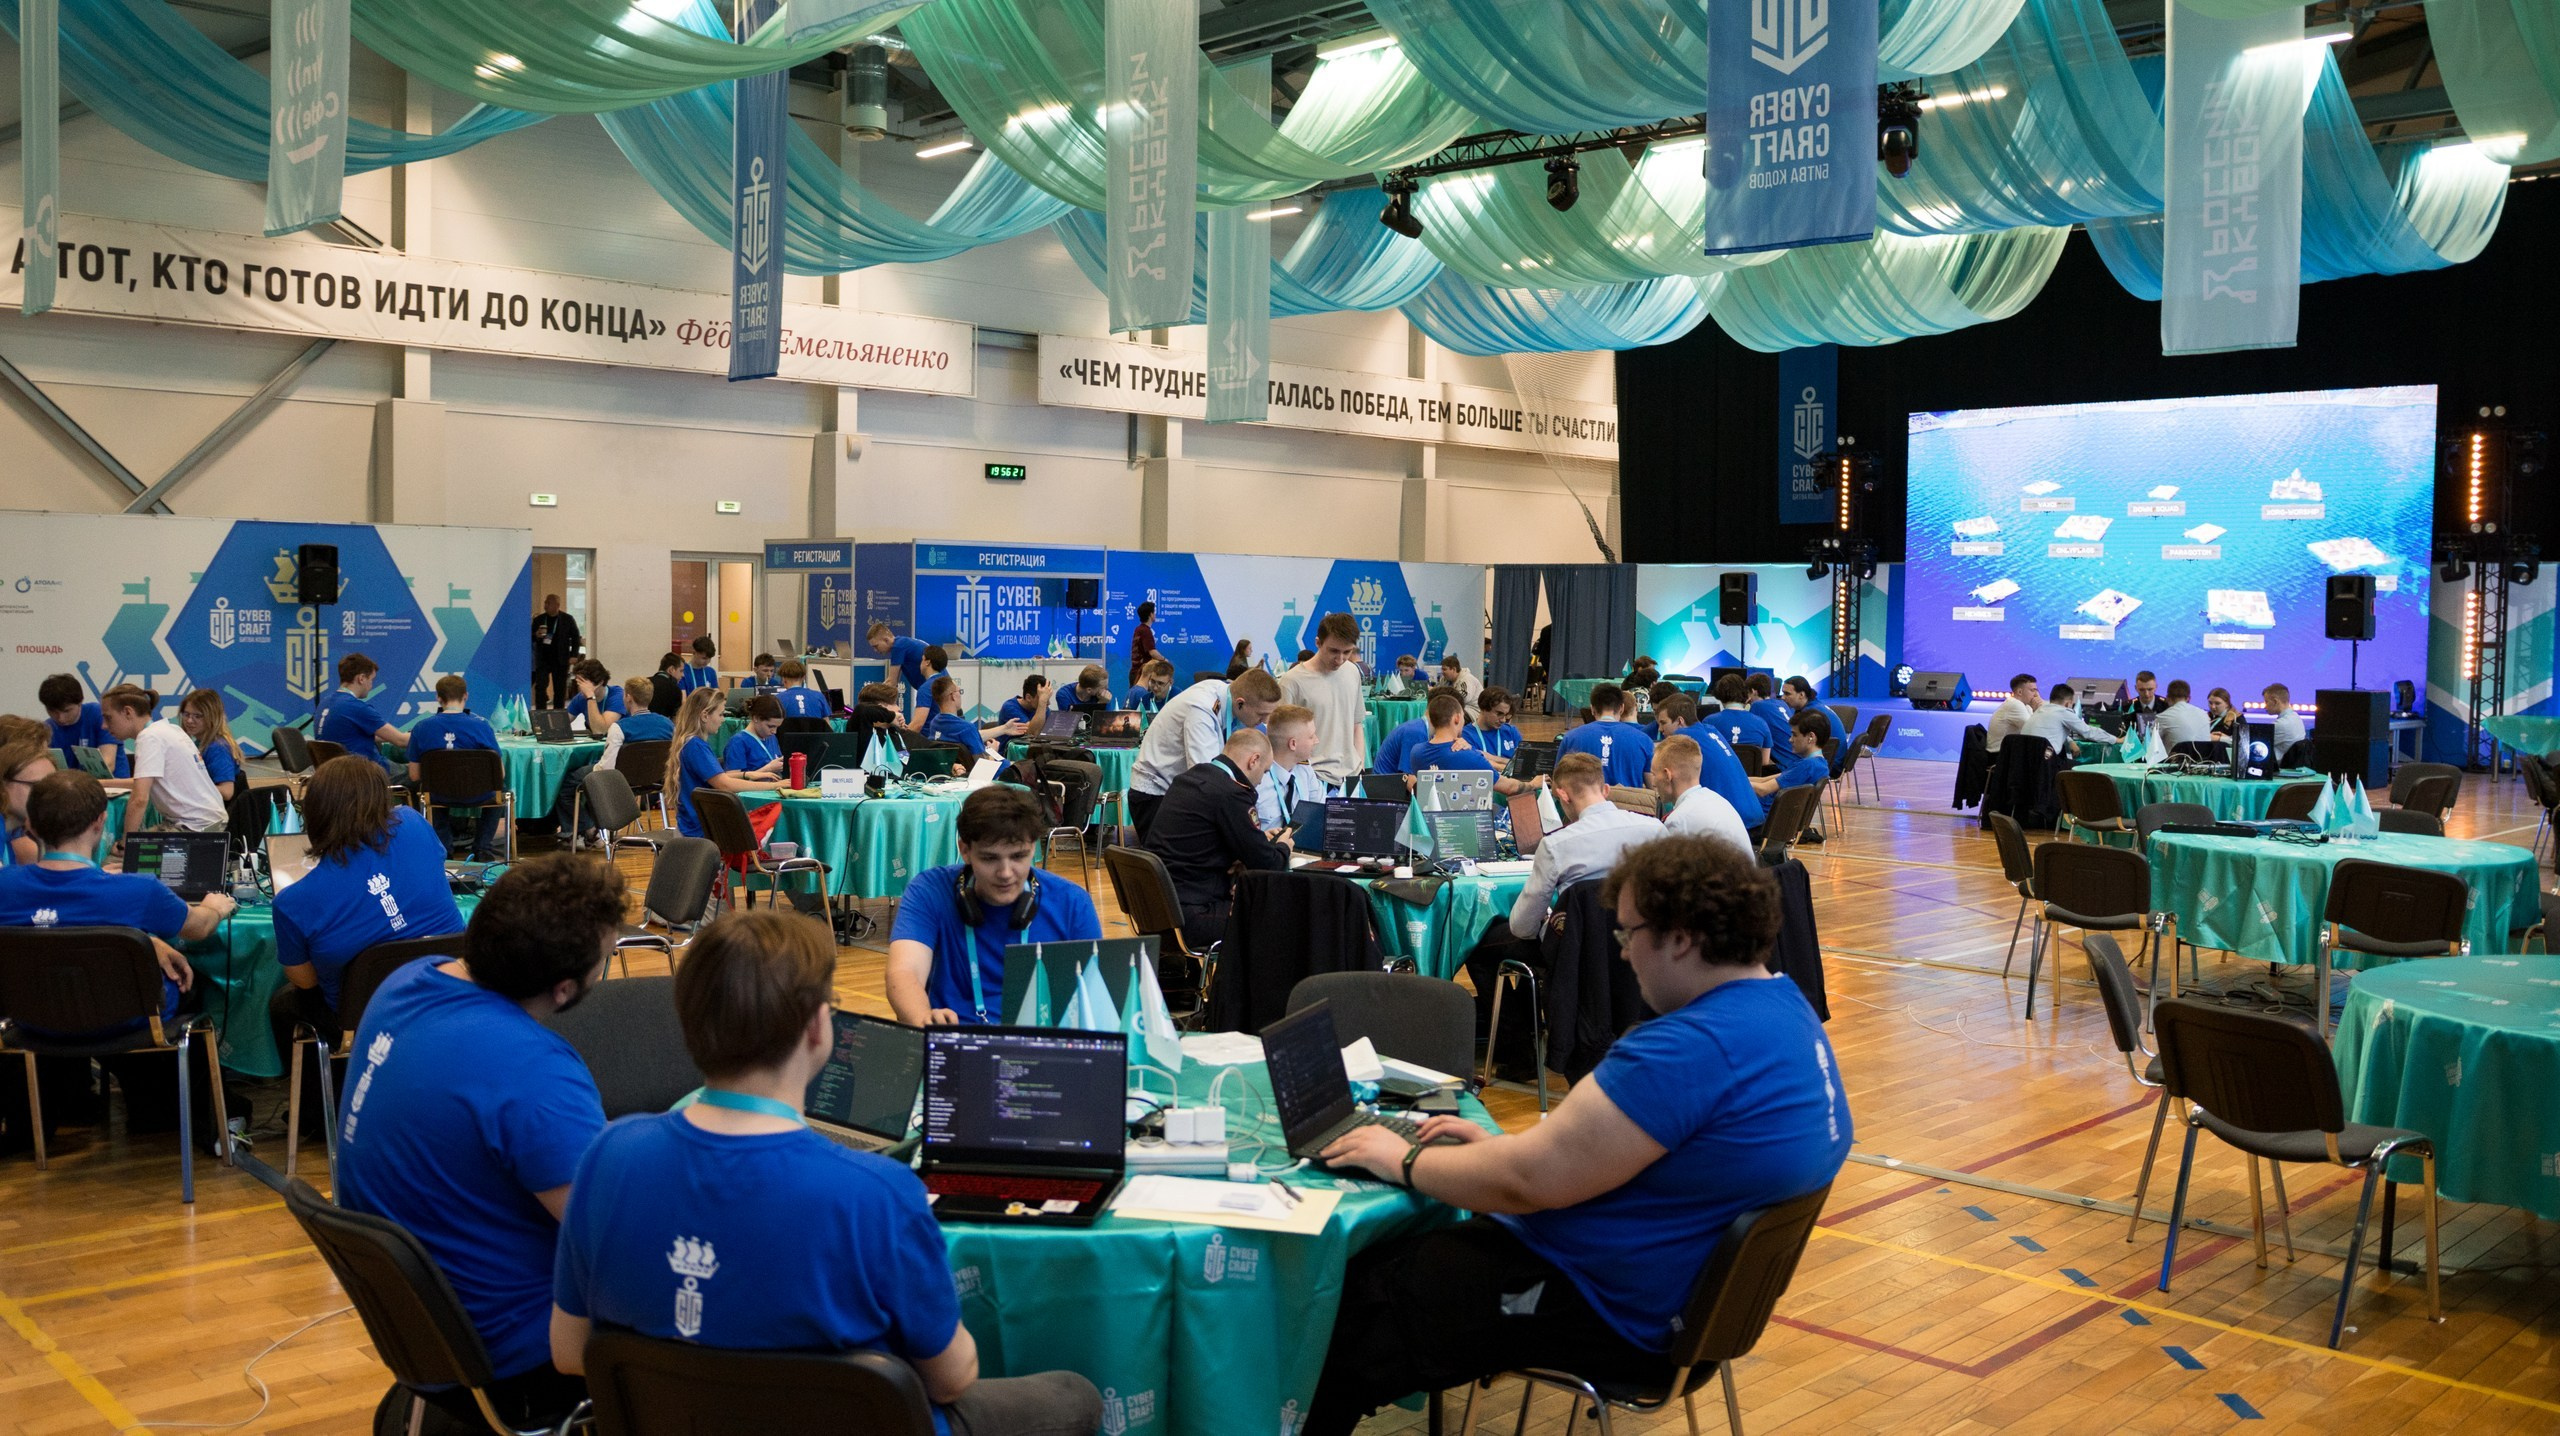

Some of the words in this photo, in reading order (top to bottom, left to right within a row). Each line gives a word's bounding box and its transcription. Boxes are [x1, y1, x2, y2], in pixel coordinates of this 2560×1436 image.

[57, 241, 138, 293] ТОТ,
[153, 252, 229, 295] КТО
[243, 264, 361, 310] ГОТОВ
[375, 278, 470, 322] ИДТИ
[481, 291, 529, 331] ДО
[541, 297, 667, 344] КОНЦА»
[676, 318, 732, 349] Фёд
[780, 328, 950, 371] Емельяненко
[1059, 358, 1121, 389] «ЧЕМ
[1128, 364, 1206, 400] ТРУДНЕ
[1268, 380, 1335, 412] ТАЛАСЬ
[1340, 389, 1413, 425] ПОБЕДА,
[1418, 398, 1451, 424] ТЕМ
[1457, 403, 1523, 433] БОЛЬШЕ
[1553, 415, 1618, 443] СЧАСТЛИ
[793, 550, 841, 564] РЕГИСТРАЦИЯ
[979, 553, 1045, 568] РЕГИСТРАЦИЯ
[997, 585, 1041, 607] CYBER
[239, 609, 271, 622] CYBER
[997, 610, 1041, 631] CRAFT
[239, 623, 271, 635] CRAFT
[997, 635, 1018, 645] БИТВА
[1019, 635, 1041, 646] КОДОВ
[1065, 633, 1116, 647] Сеерстль
[16, 645, 63, 655] ПЛОЩАДЬ
